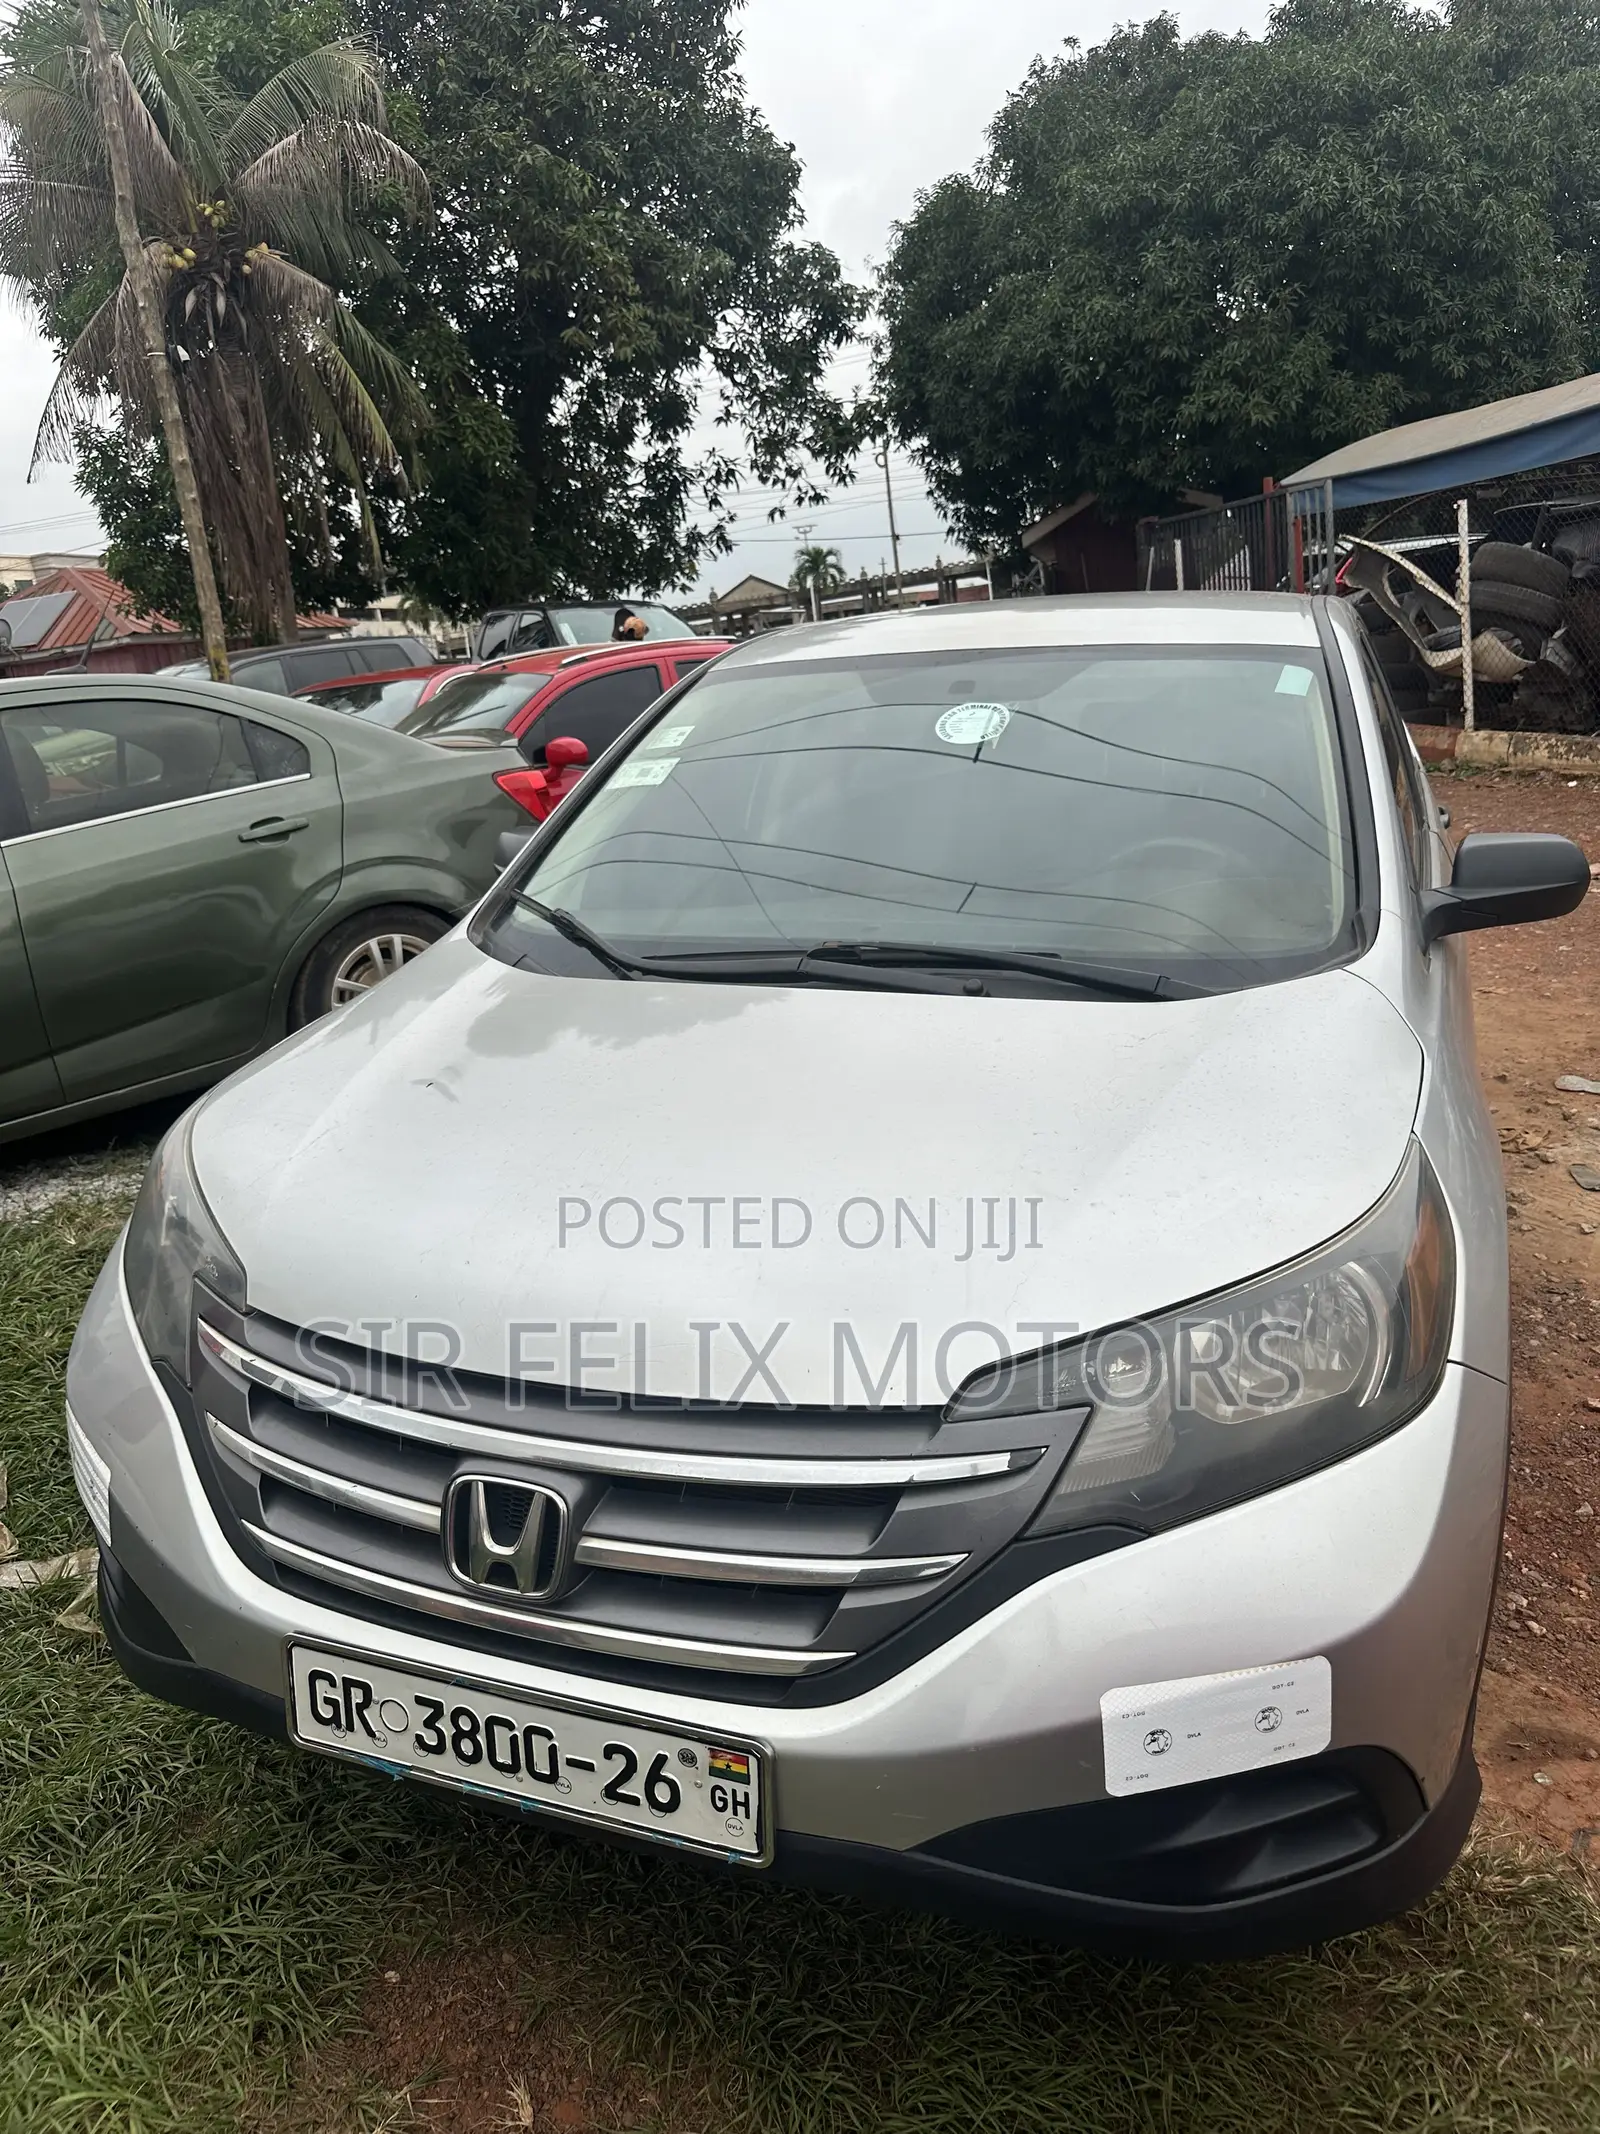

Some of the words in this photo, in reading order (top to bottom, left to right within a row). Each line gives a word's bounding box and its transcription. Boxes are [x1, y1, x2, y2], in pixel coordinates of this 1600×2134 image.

[308, 1668, 378, 1738] GR
[414, 1693, 682, 1814] 3800-26
[710, 1784, 751, 1820] GH
[727, 1823, 744, 1832] DVLA
